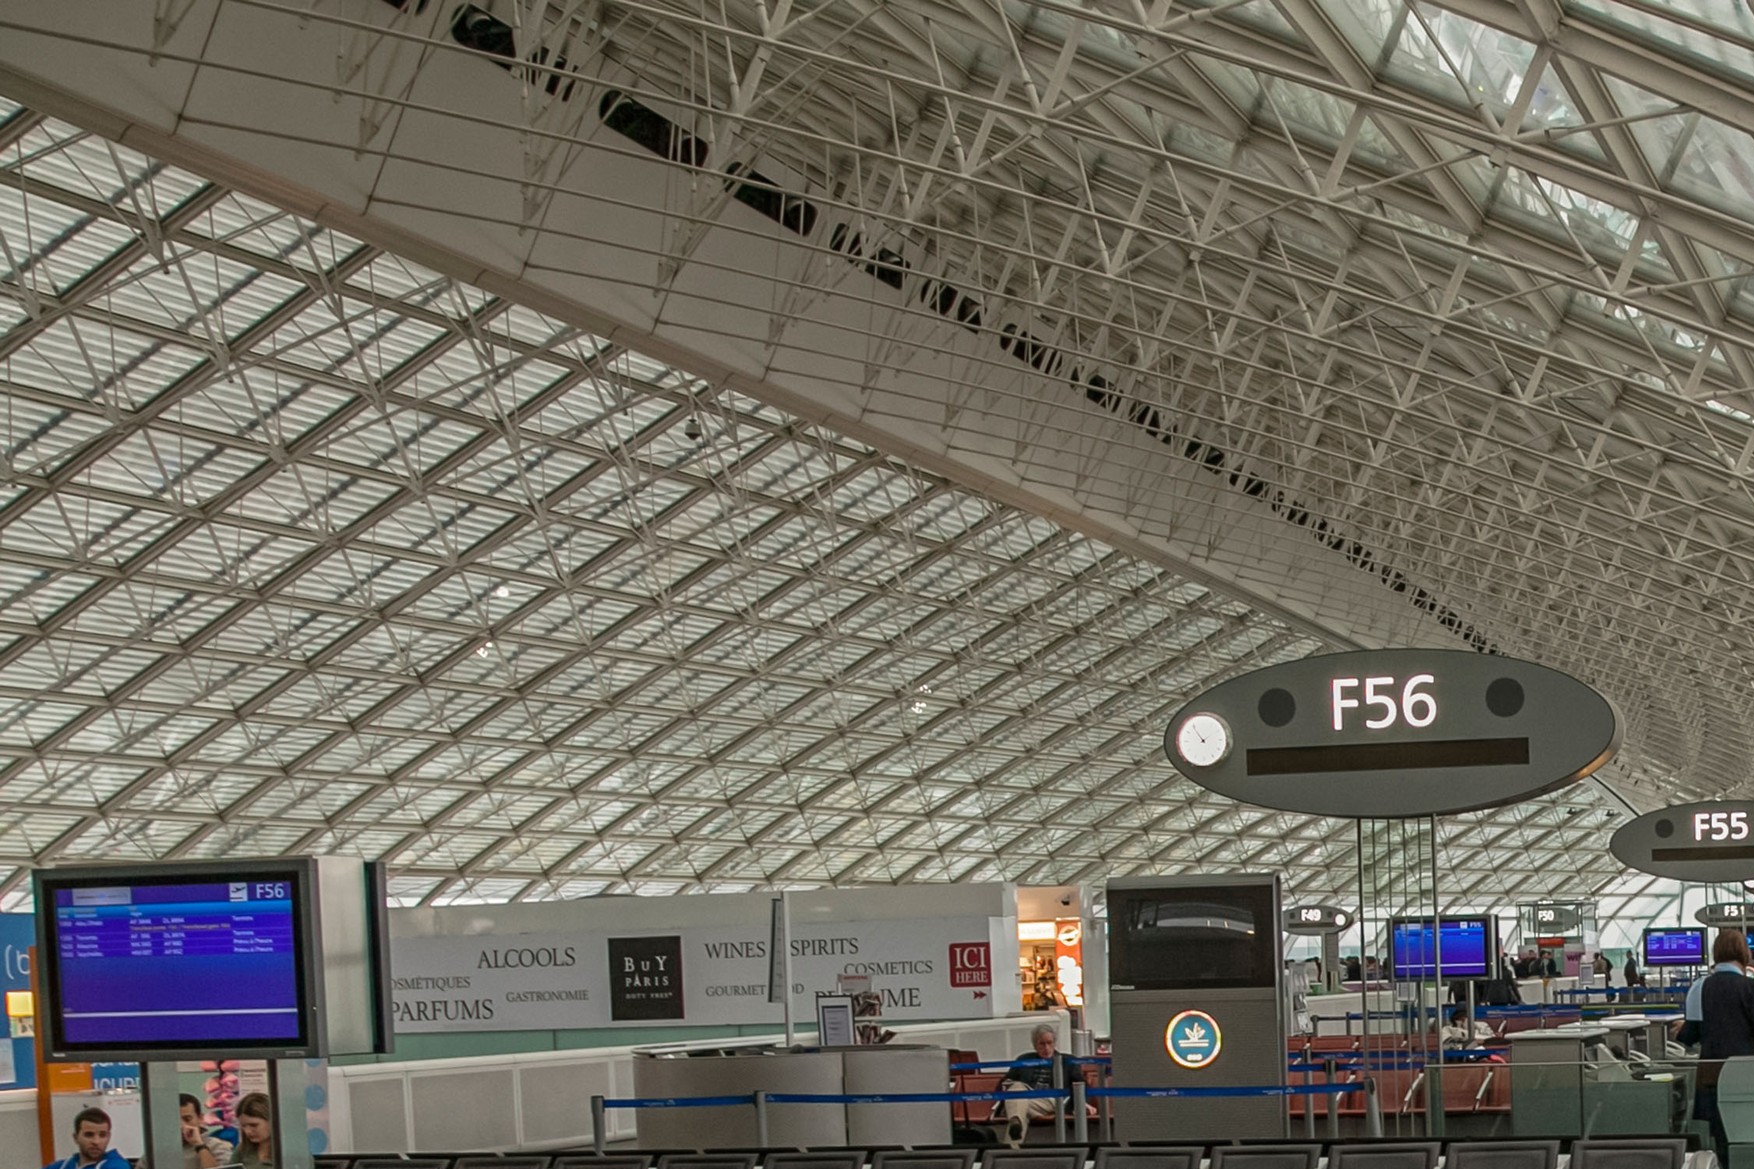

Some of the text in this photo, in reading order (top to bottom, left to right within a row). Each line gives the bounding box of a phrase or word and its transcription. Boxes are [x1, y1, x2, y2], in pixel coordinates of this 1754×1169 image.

[1331, 674, 1437, 730] F56
[1694, 812, 1749, 841] F55
[256, 883, 285, 899] F56
[1301, 908, 1322, 922] F49
[1538, 910, 1555, 922] F50
[704, 937, 859, 959] WINES SPIRITS
[477, 947, 576, 969] ALCOOLS
[954, 947, 987, 969] ICI
[844, 960, 933, 975] COSMETICS
[391, 976, 471, 991] OSMÉTIQUES
[625, 973, 669, 987] PARIS
[955, 970, 988, 984] HERE
[506, 990, 589, 1002] GASTRONOMIE
[705, 984, 766, 997] GOURMET
